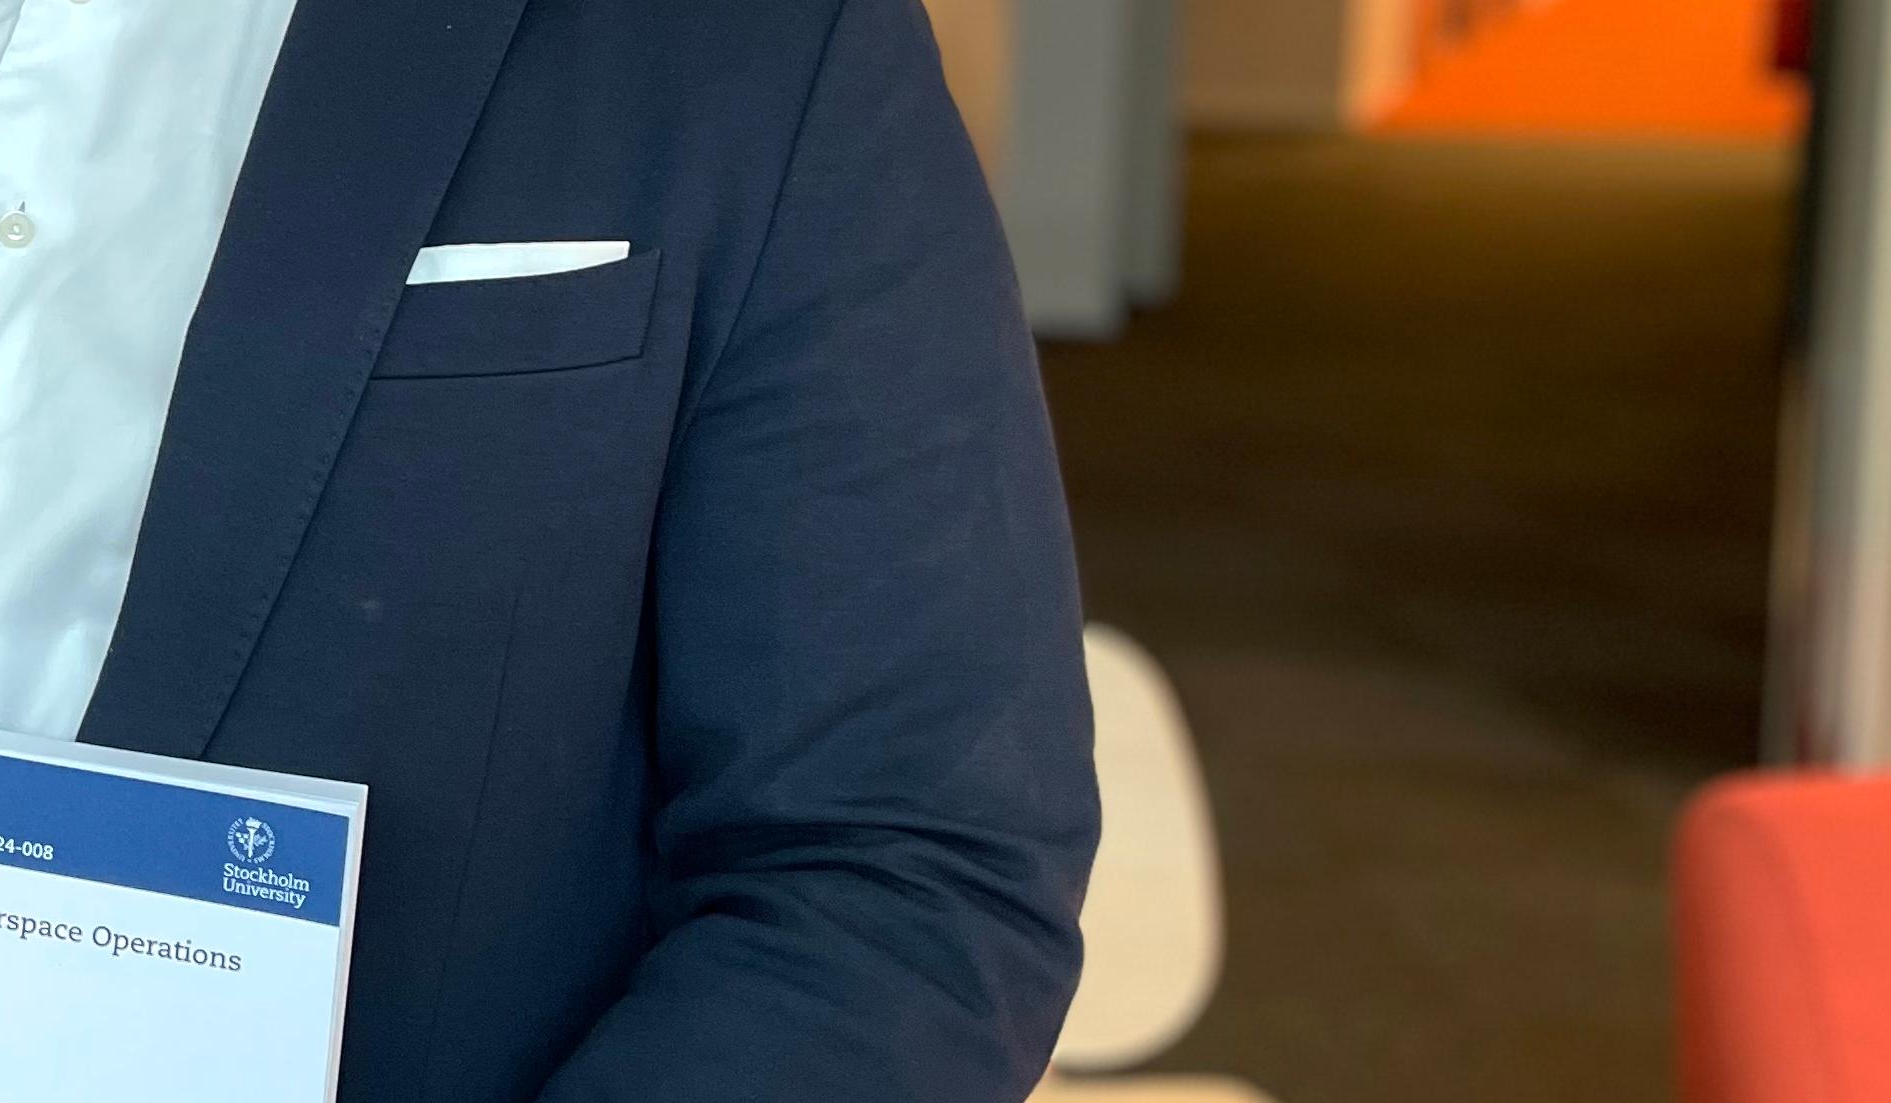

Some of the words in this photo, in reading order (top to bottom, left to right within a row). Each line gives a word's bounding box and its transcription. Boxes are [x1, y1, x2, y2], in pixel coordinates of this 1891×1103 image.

[222, 876, 307, 909] University
[223, 862, 310, 892] Stockholm
[92, 925, 242, 972] Operations
